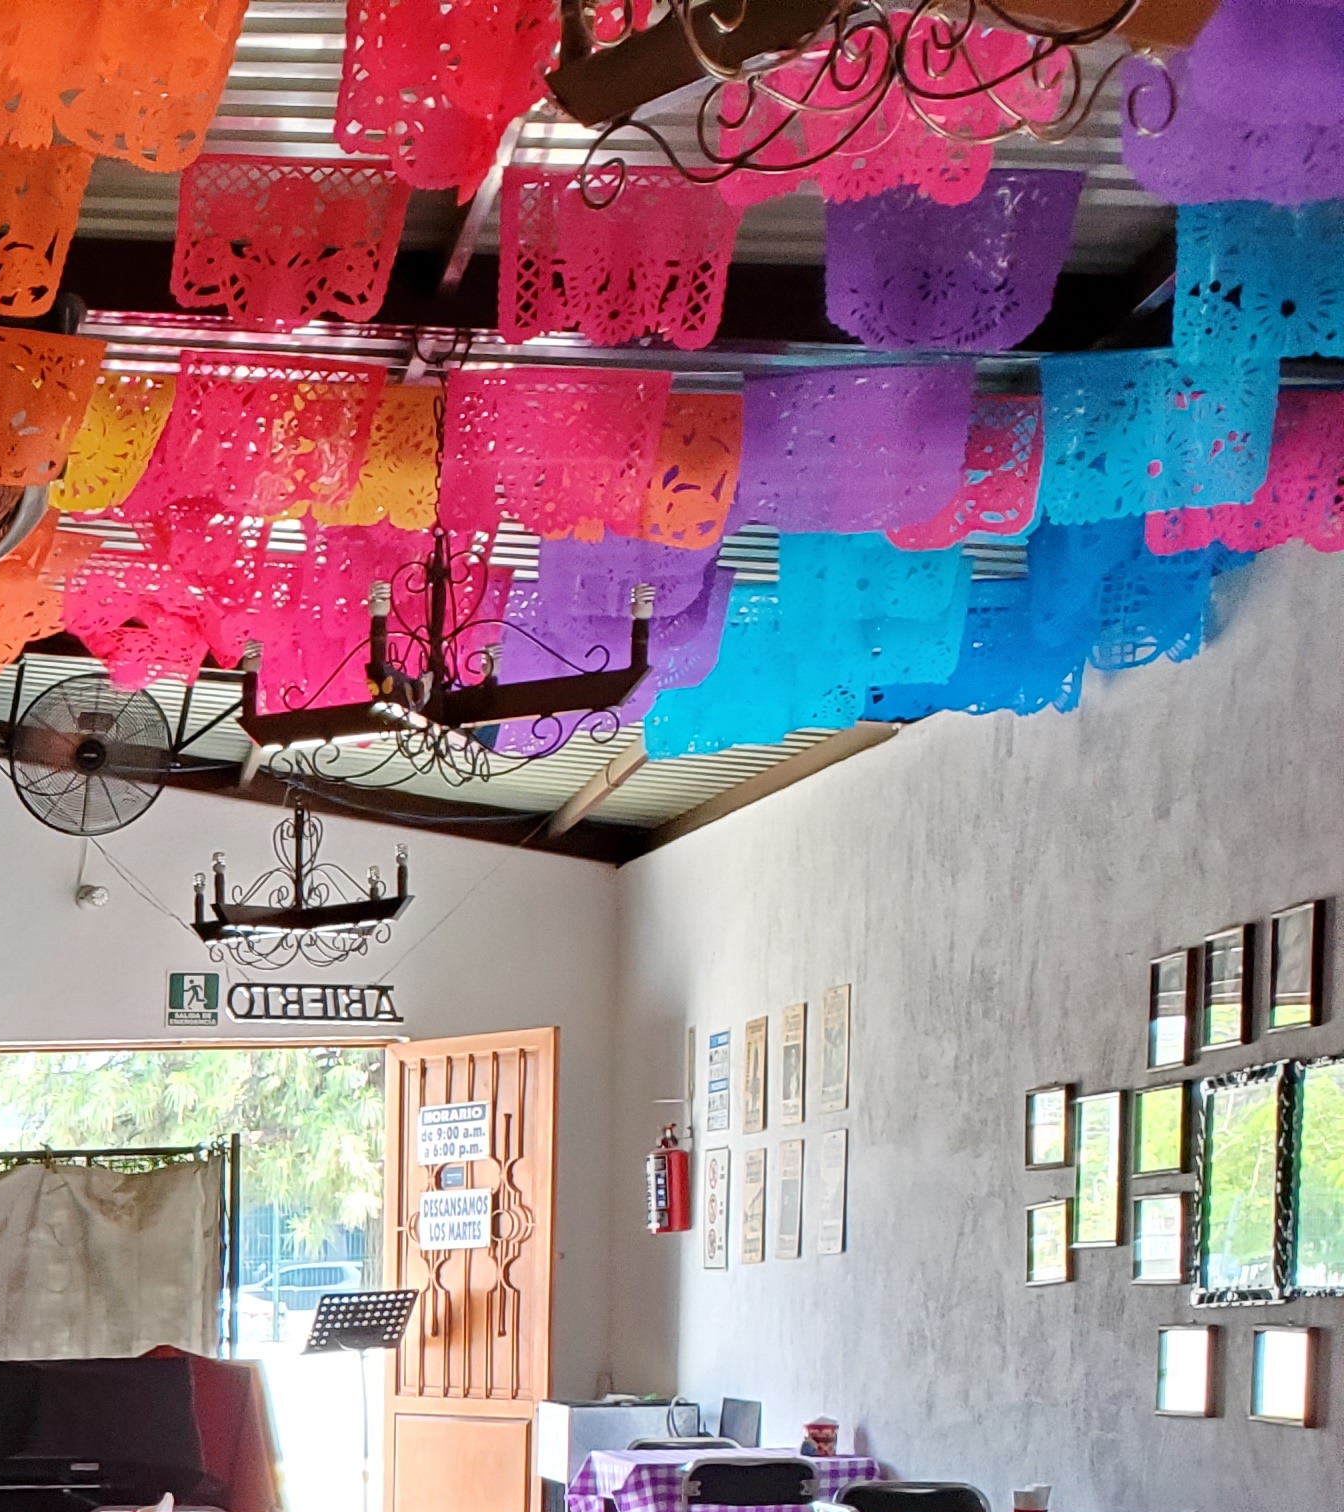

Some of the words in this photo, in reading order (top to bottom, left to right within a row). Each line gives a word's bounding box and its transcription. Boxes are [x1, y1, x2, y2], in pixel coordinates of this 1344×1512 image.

[423, 1106, 483, 1124] HORARIO
[421, 1129, 433, 1142] de
[436, 1126, 459, 1140] 9:00
[463, 1127, 486, 1139] a.m.
[424, 1147, 430, 1158] a
[433, 1142, 455, 1157] 6:00
[459, 1143, 483, 1158] p.m.
[423, 1195, 488, 1218] DESCANSAMOS
[429, 1222, 446, 1242] LOS
[448, 1220, 482, 1241] MARTES
